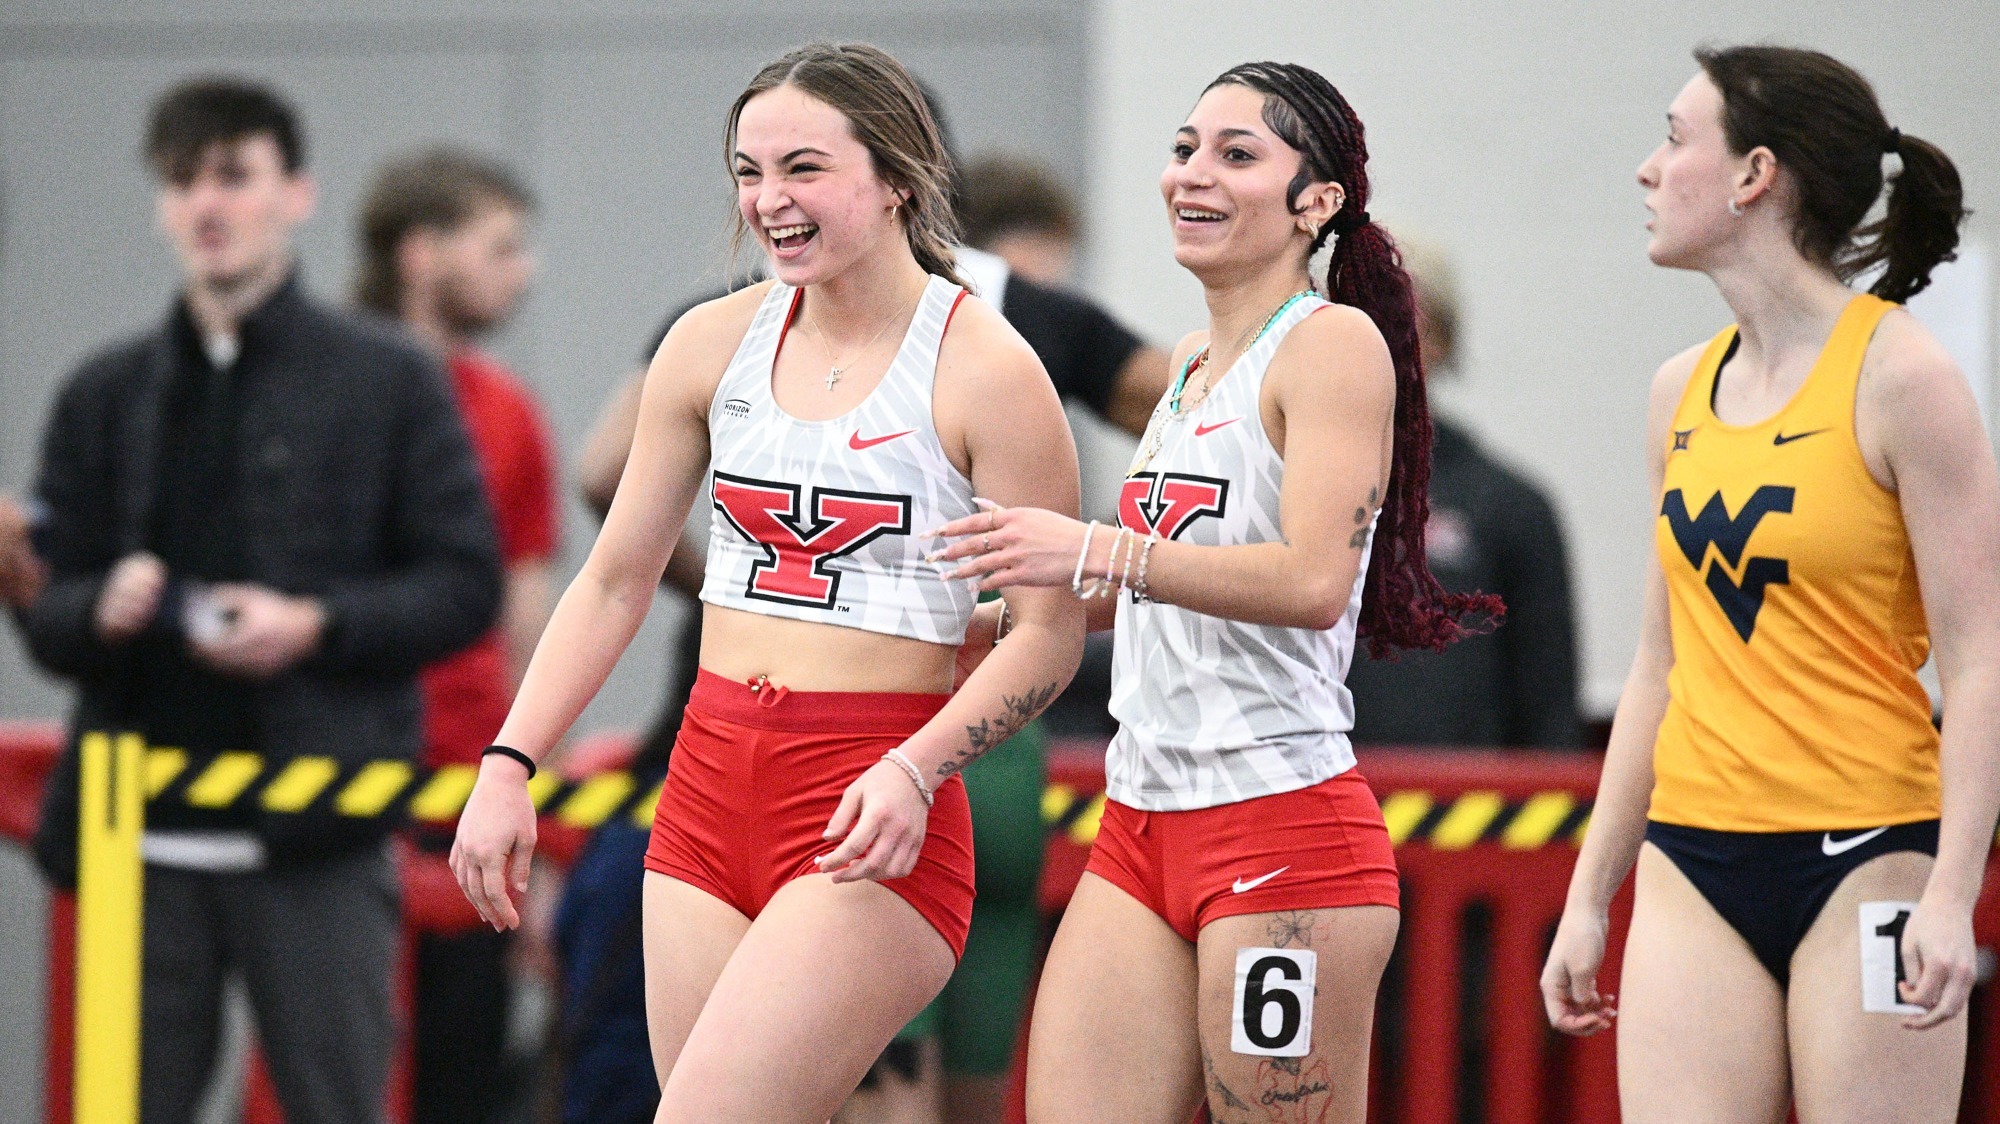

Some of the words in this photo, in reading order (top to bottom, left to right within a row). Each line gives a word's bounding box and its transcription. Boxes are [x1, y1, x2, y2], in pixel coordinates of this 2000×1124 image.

[725, 403, 750, 413] HORIZON
[712, 469, 912, 610] Y
[1116, 471, 1230, 546] Y
[837, 605, 850, 613] TM
[1875, 910, 1911, 1005] 1
[1243, 956, 1302, 1049] 6
